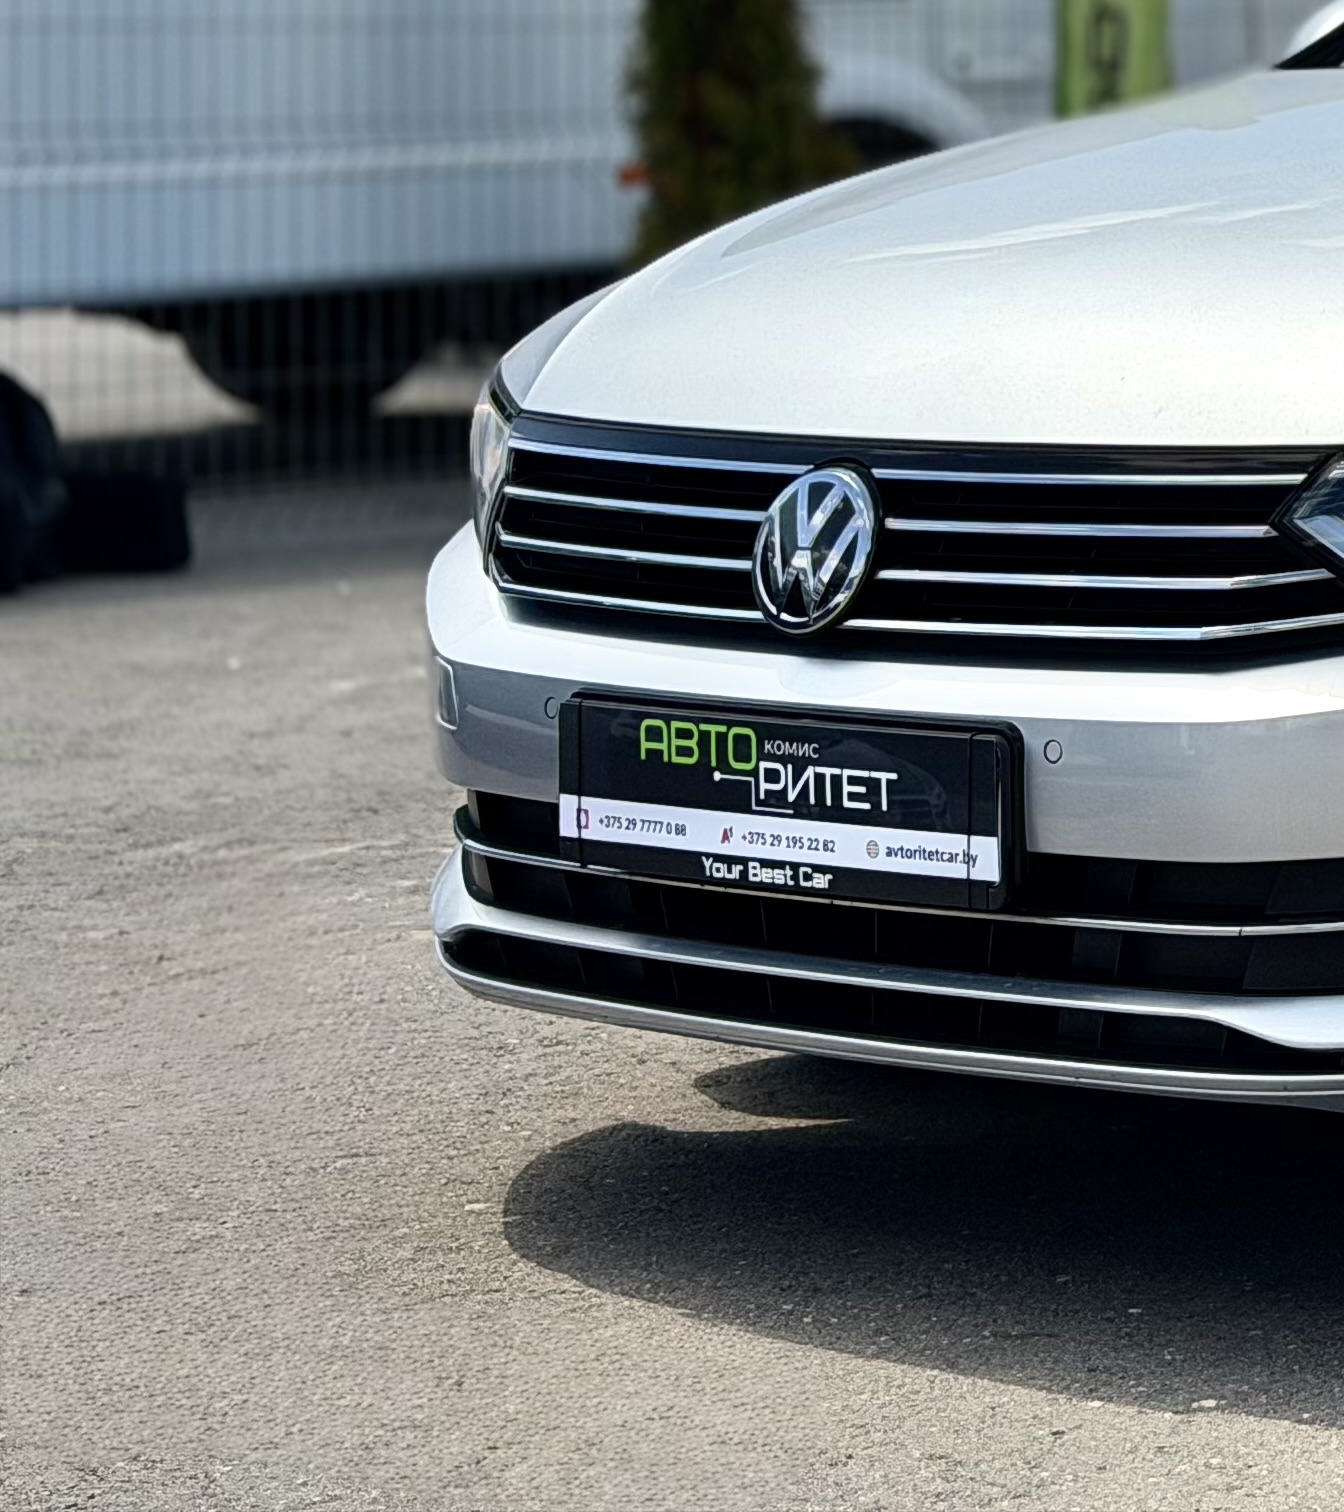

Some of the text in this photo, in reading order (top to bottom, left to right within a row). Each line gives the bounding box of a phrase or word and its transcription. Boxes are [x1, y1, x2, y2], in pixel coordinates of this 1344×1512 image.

[640, 719, 757, 771] АВТО
[763, 739, 820, 759] КОМИС
[758, 760, 898, 811] РИТЕТ
[598, 814, 623, 830] +375
[624, 817, 637, 831] 29
[639, 818, 664, 834] 7777
[741, 830, 768, 846] +375
[769, 833, 783, 848] 29
[785, 835, 805, 850] 195
[806, 837, 821, 851] 22
[885, 844, 979, 868] avtoritetcar.by
[701, 855, 834, 890] Your Best Car
